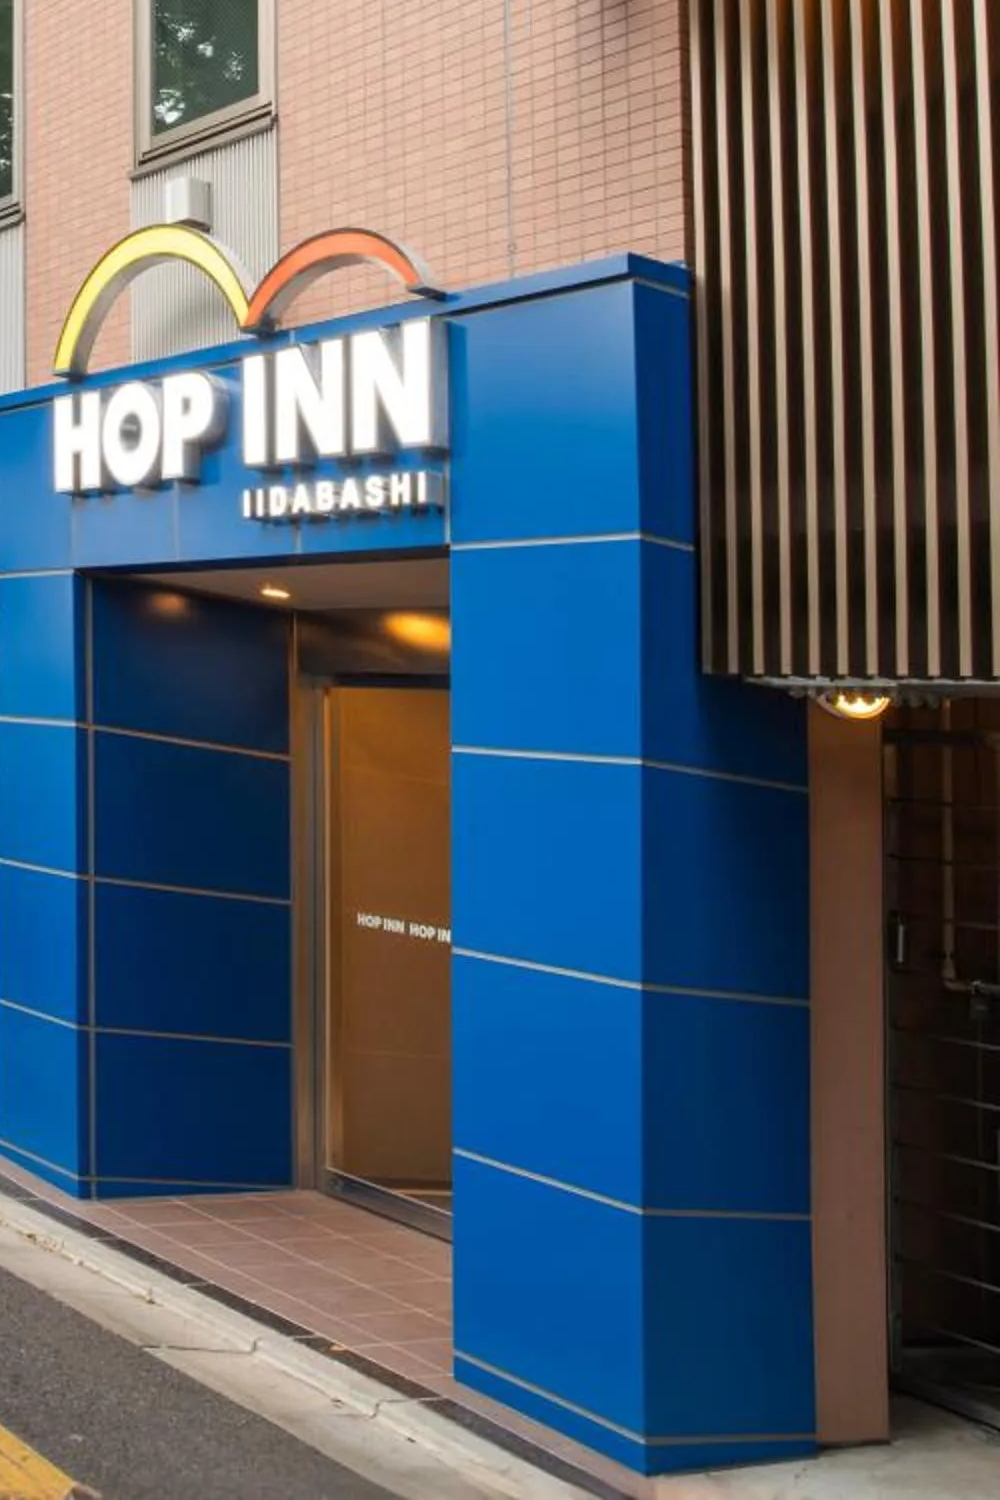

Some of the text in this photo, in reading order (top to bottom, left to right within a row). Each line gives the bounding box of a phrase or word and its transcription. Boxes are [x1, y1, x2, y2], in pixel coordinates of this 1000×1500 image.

[54, 317, 432, 492] HOP INN
[243, 471, 428, 518] IIDABASHI
[357, 912, 451, 943] HOP INN HOP IN
